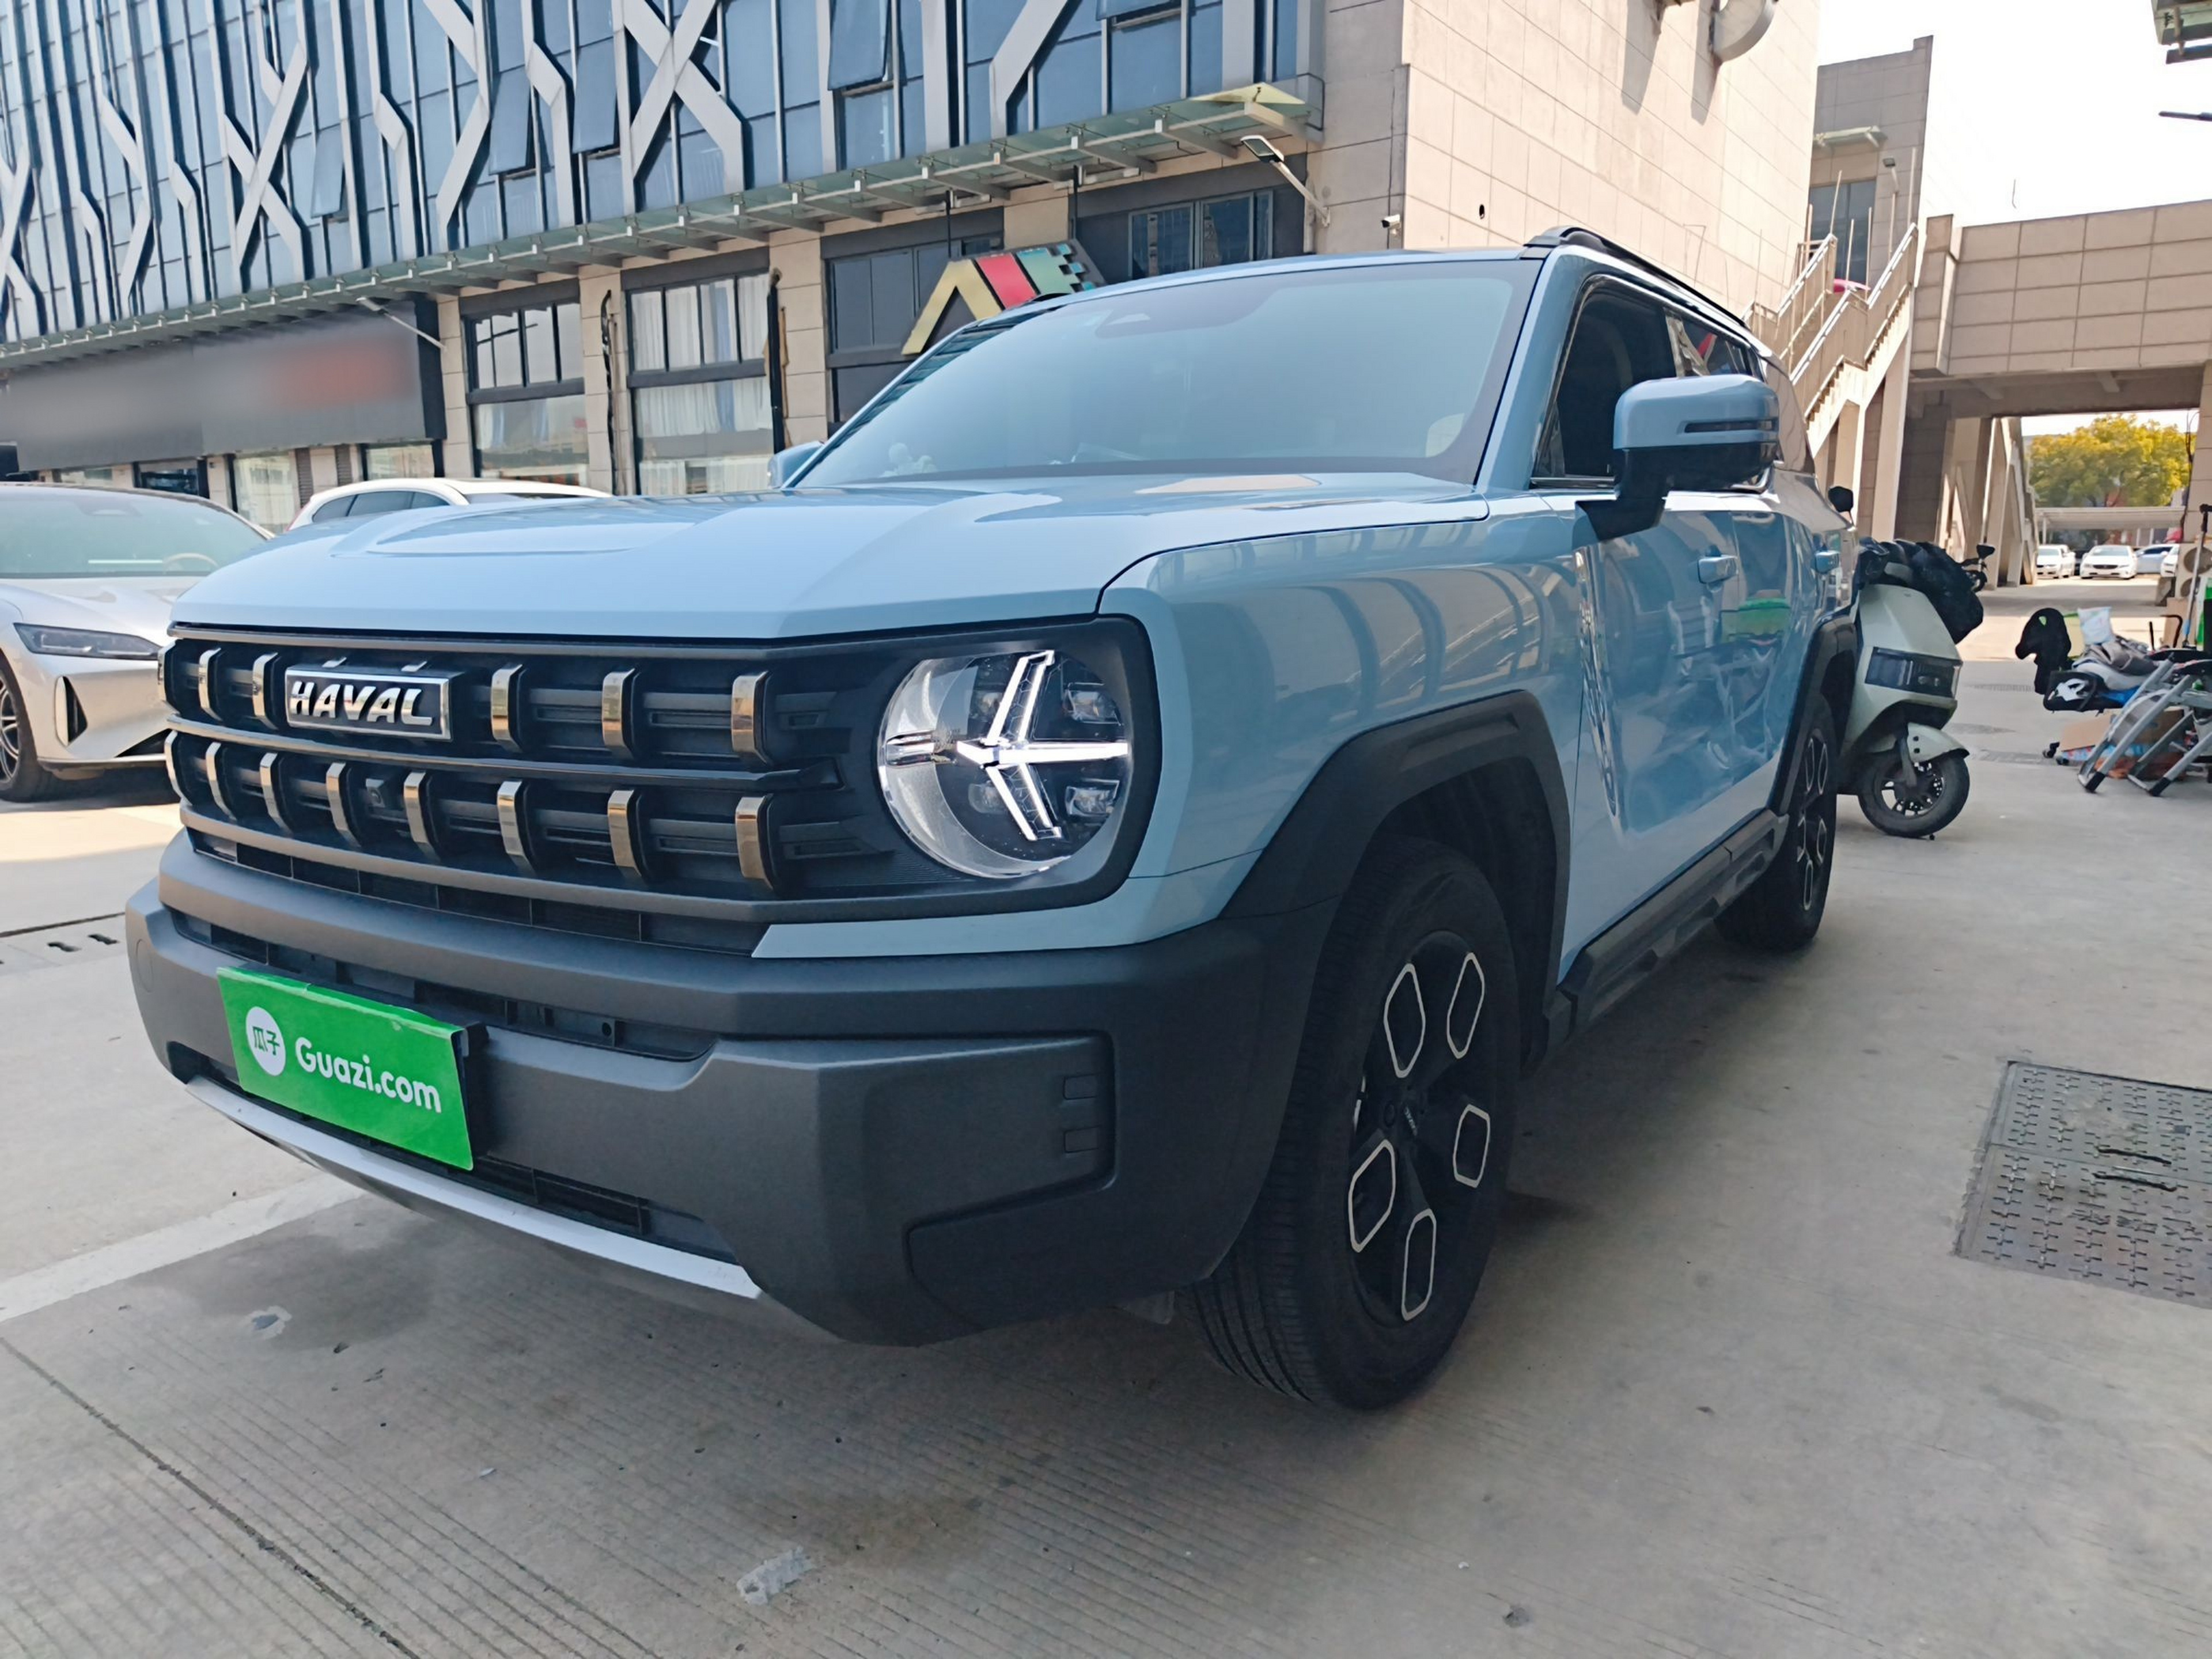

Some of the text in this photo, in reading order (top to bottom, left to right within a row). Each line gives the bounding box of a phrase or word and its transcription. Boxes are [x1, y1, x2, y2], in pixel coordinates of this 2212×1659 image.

[290, 681, 433, 726] HAVAL
[252, 1026, 280, 1055] 瓜子
[295, 1037, 442, 1113] Guazi.com
